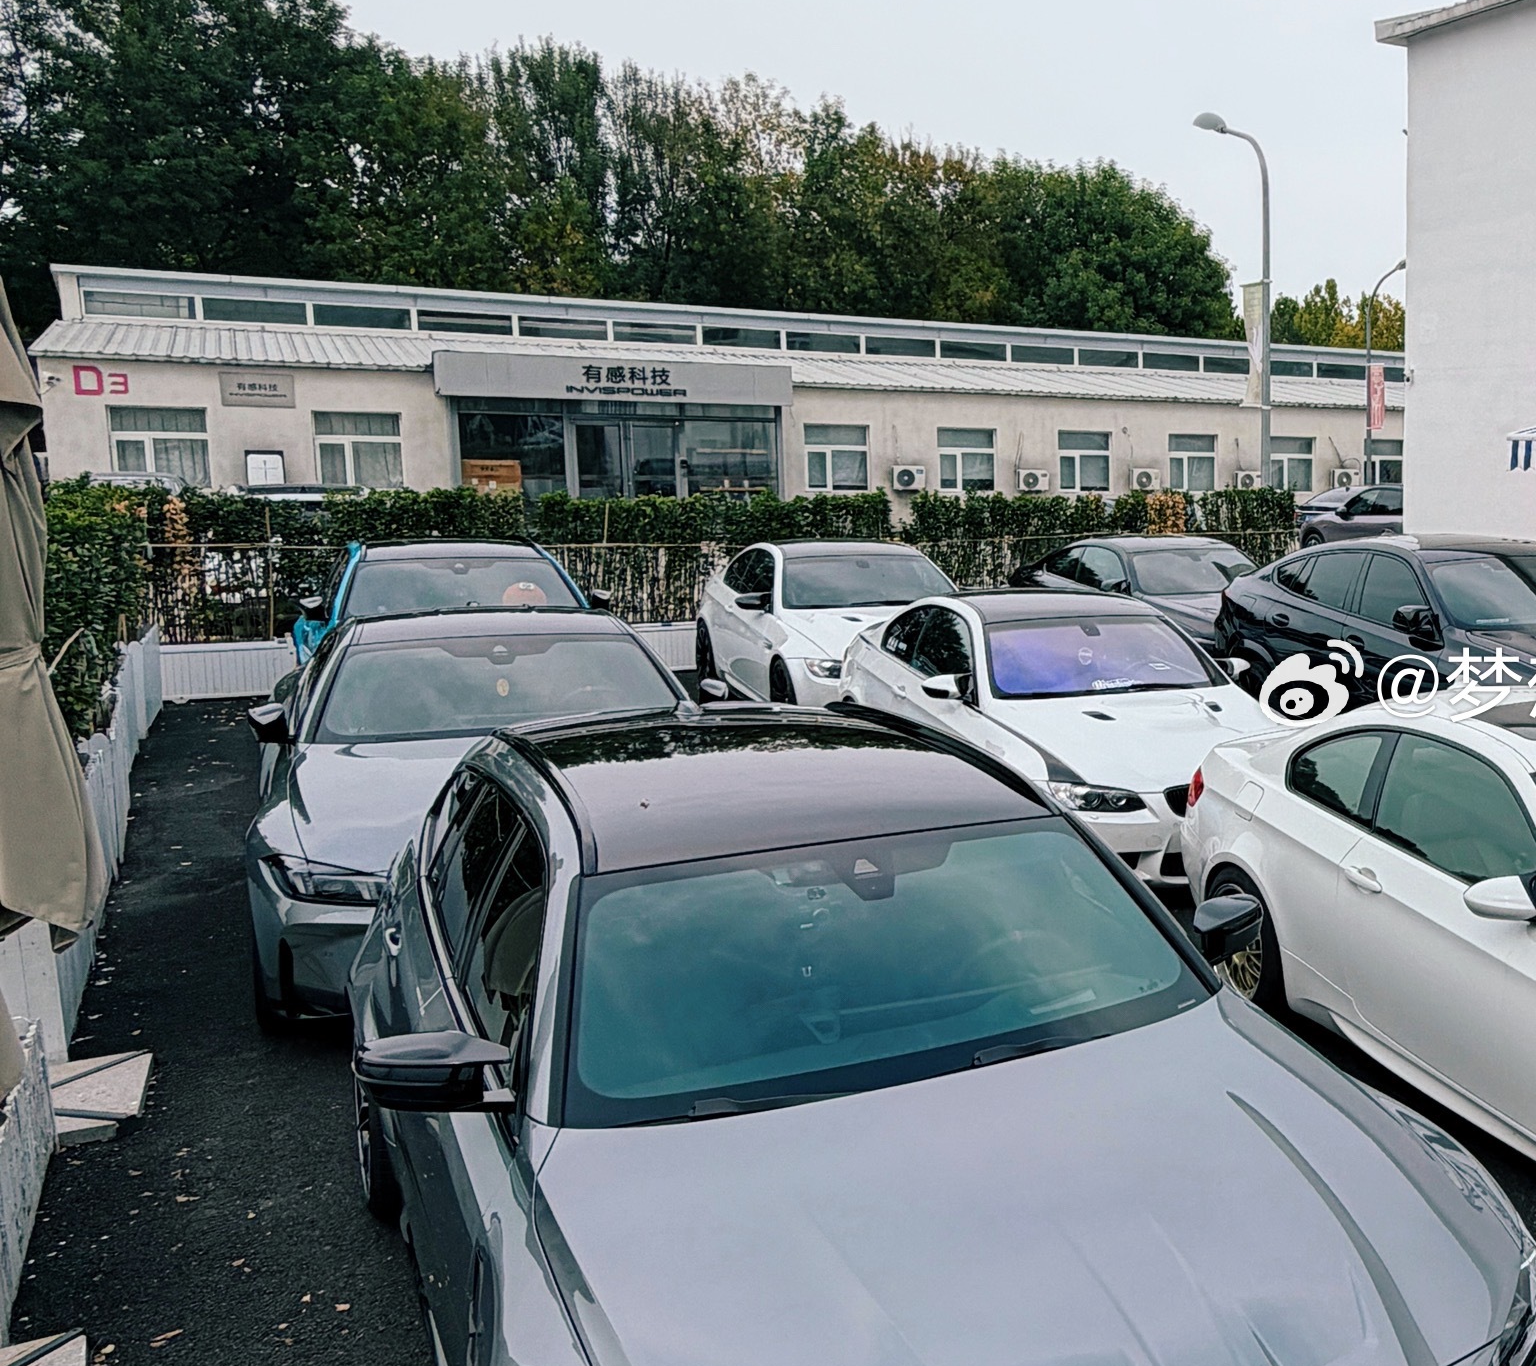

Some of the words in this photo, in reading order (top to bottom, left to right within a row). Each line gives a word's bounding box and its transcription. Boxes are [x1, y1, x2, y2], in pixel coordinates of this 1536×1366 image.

[72, 365, 129, 396] D3
[582, 365, 671, 386] 有感科技
[566, 385, 687, 397] INVISPOWER
